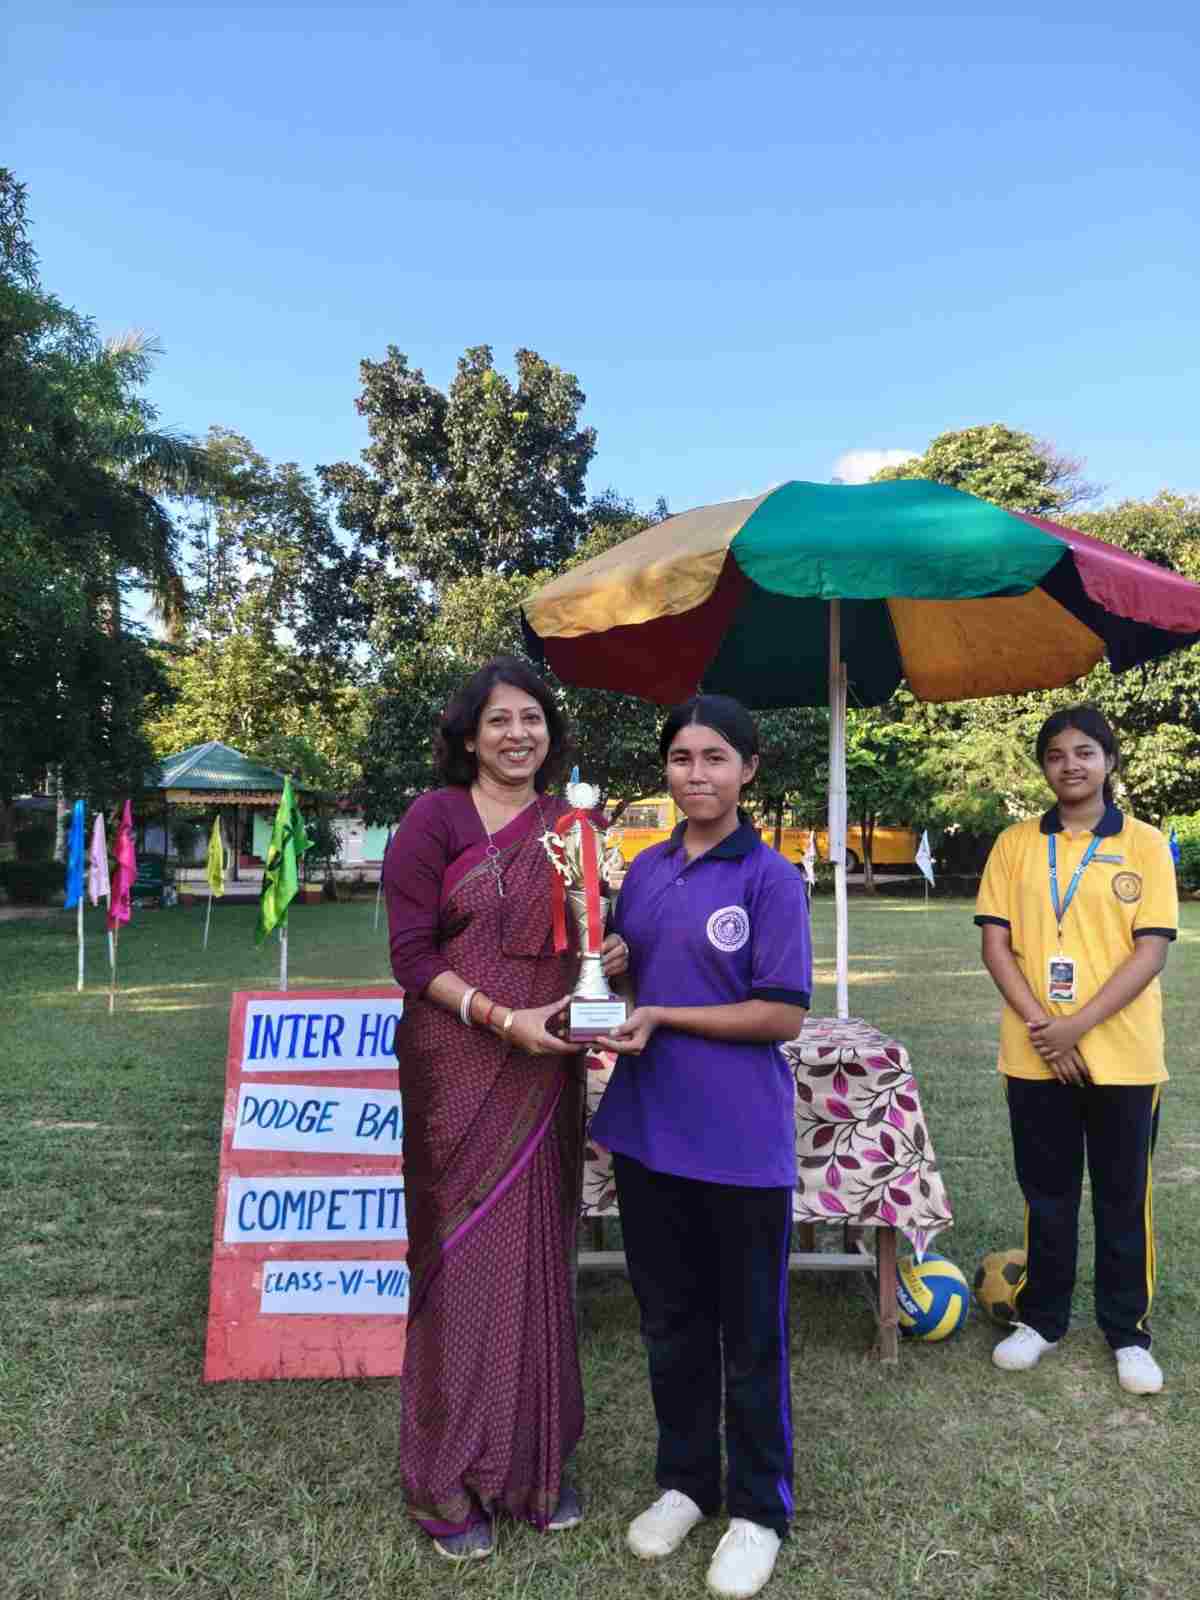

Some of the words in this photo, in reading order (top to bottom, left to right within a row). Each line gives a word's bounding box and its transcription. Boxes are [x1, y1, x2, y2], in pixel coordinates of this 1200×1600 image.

[248, 1014, 345, 1060] INTER
[240, 1096, 340, 1133] DODGE
[356, 1103, 403, 1141] BA
